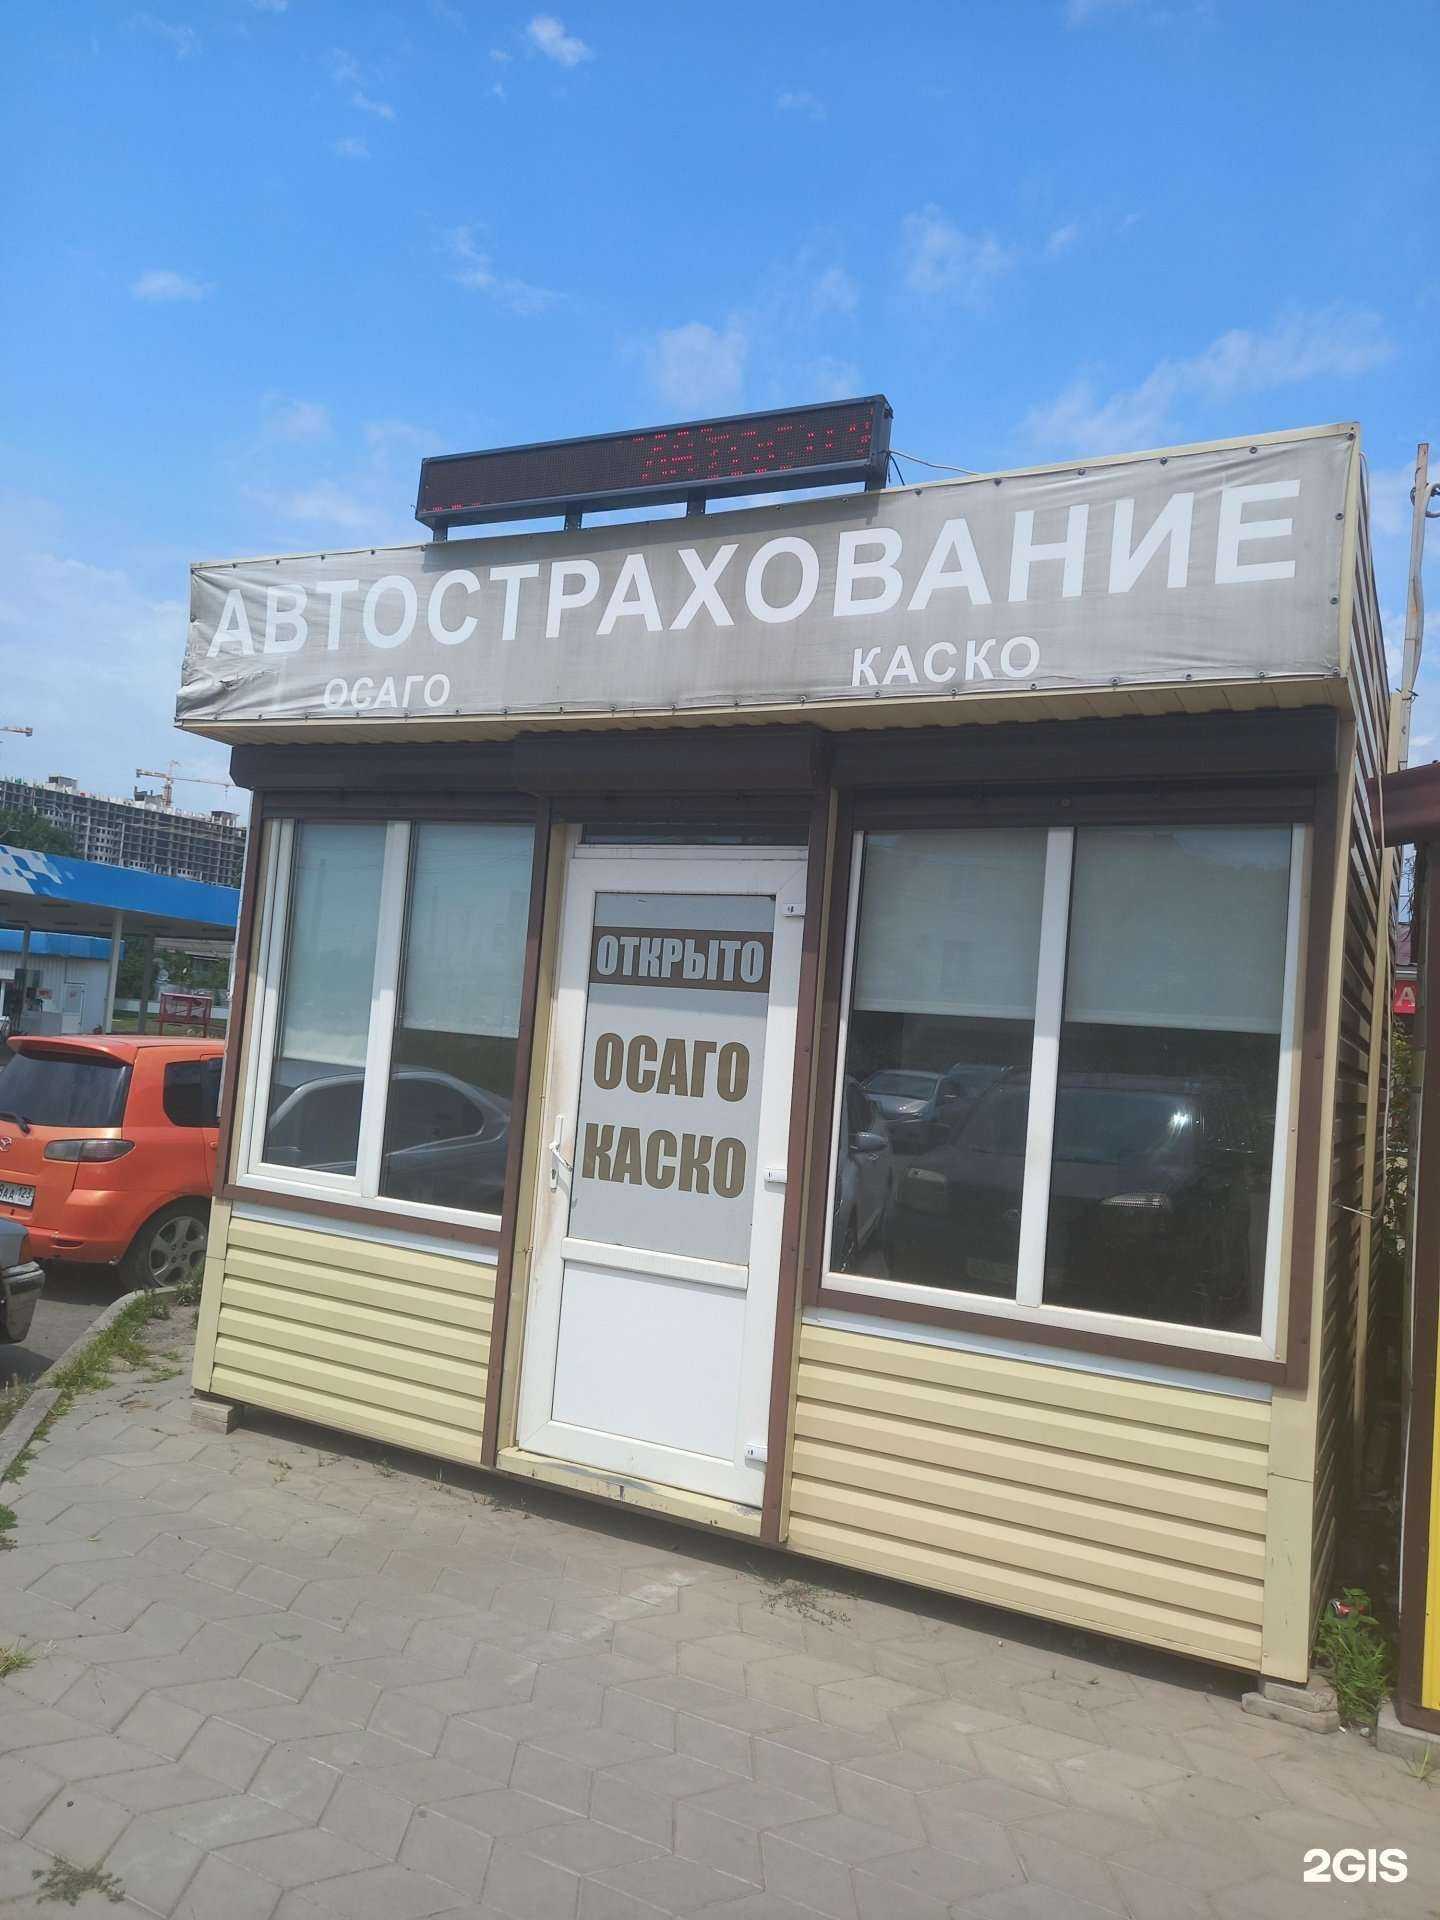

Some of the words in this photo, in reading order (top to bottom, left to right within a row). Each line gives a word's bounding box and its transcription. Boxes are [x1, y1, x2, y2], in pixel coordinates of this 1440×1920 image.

[207, 480, 1300, 658] АВТОСТРАХОВАНИЕ
[323, 673, 451, 710] ОСАГО
[851, 636, 1040, 687] КАСКО
[597, 935, 764, 983] ОТКРЫТО
[593, 1032, 750, 1102] ОСАГО
[582, 1122, 746, 1198] КАСКО
